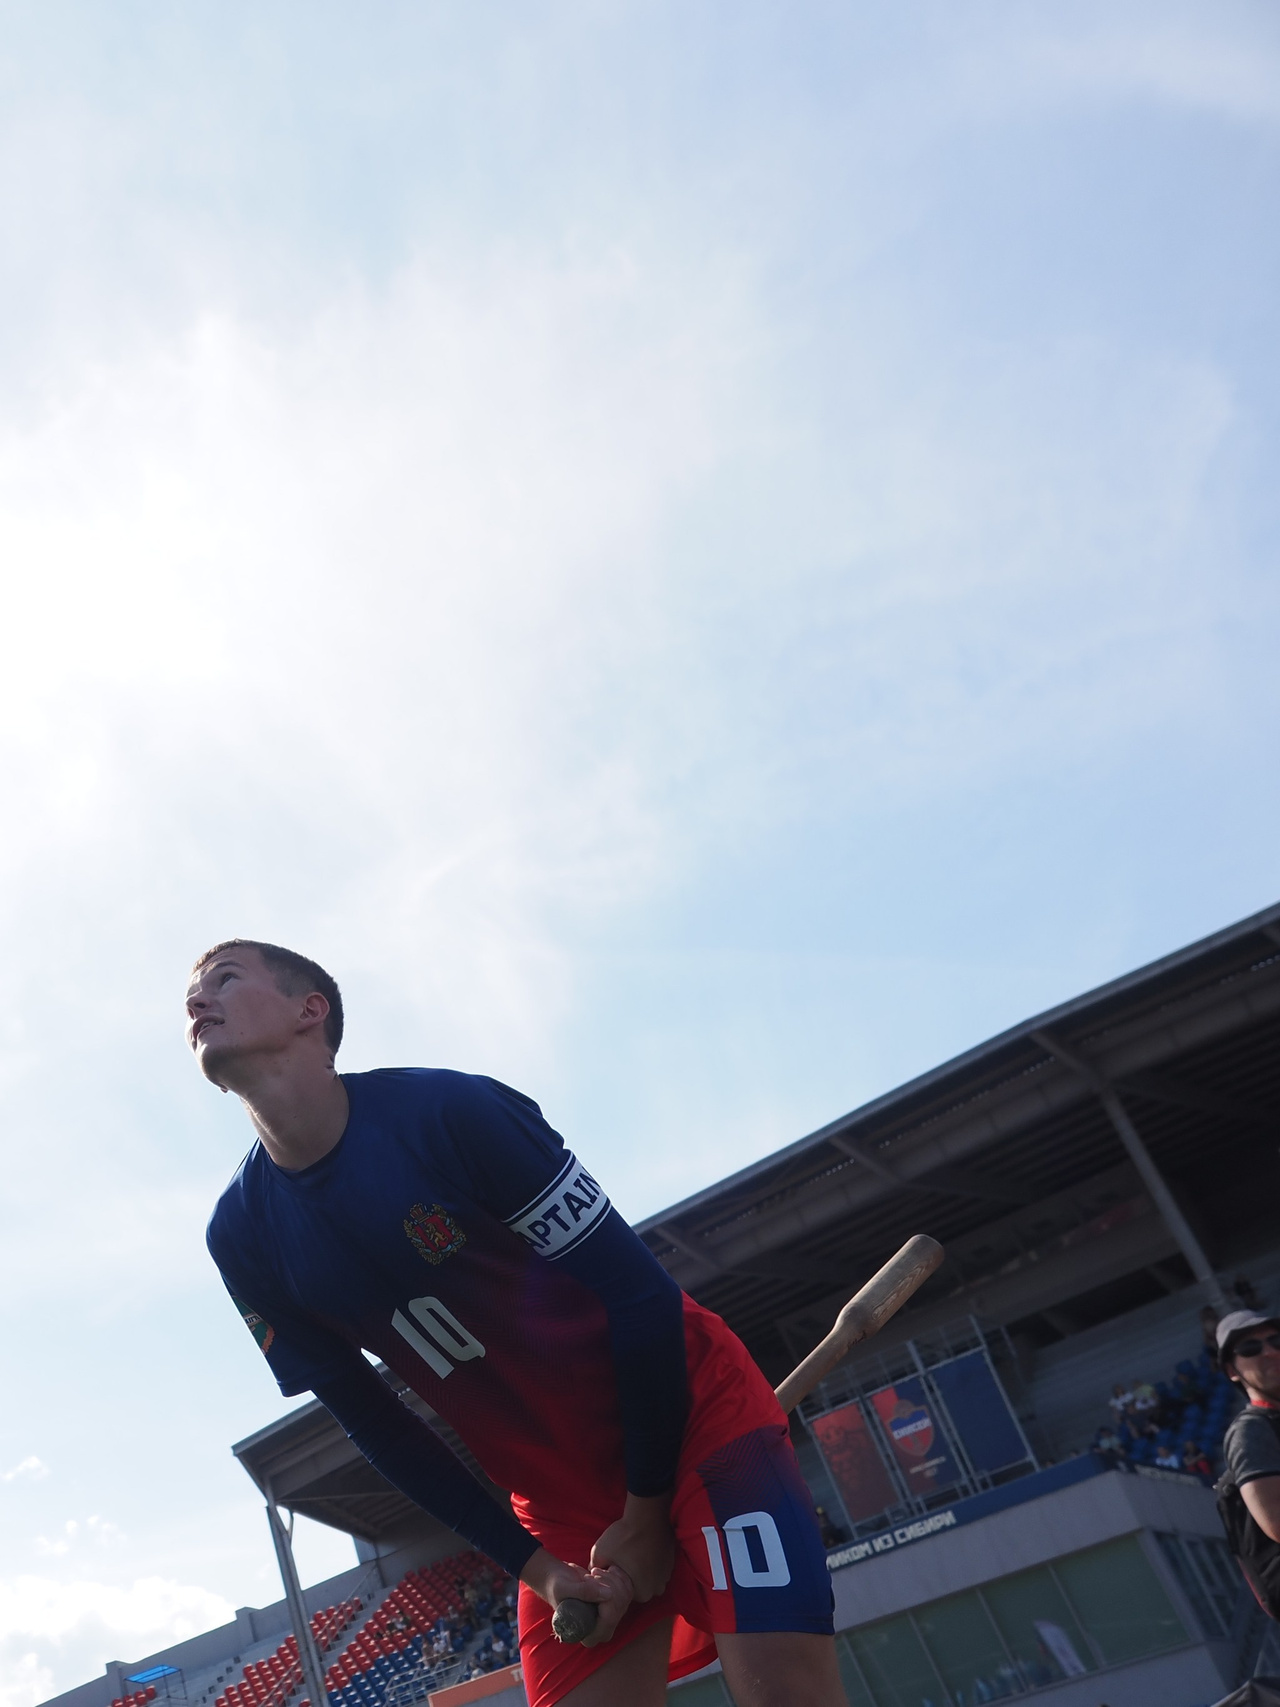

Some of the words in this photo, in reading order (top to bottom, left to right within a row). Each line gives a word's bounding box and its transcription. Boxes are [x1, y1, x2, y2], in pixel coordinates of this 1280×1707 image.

[391, 1296, 486, 1380] 10
[701, 1511, 791, 1591] 10
[871, 1533, 895, 1552] ИЗ
[893, 1510, 957, 1544] СИБИРИ
